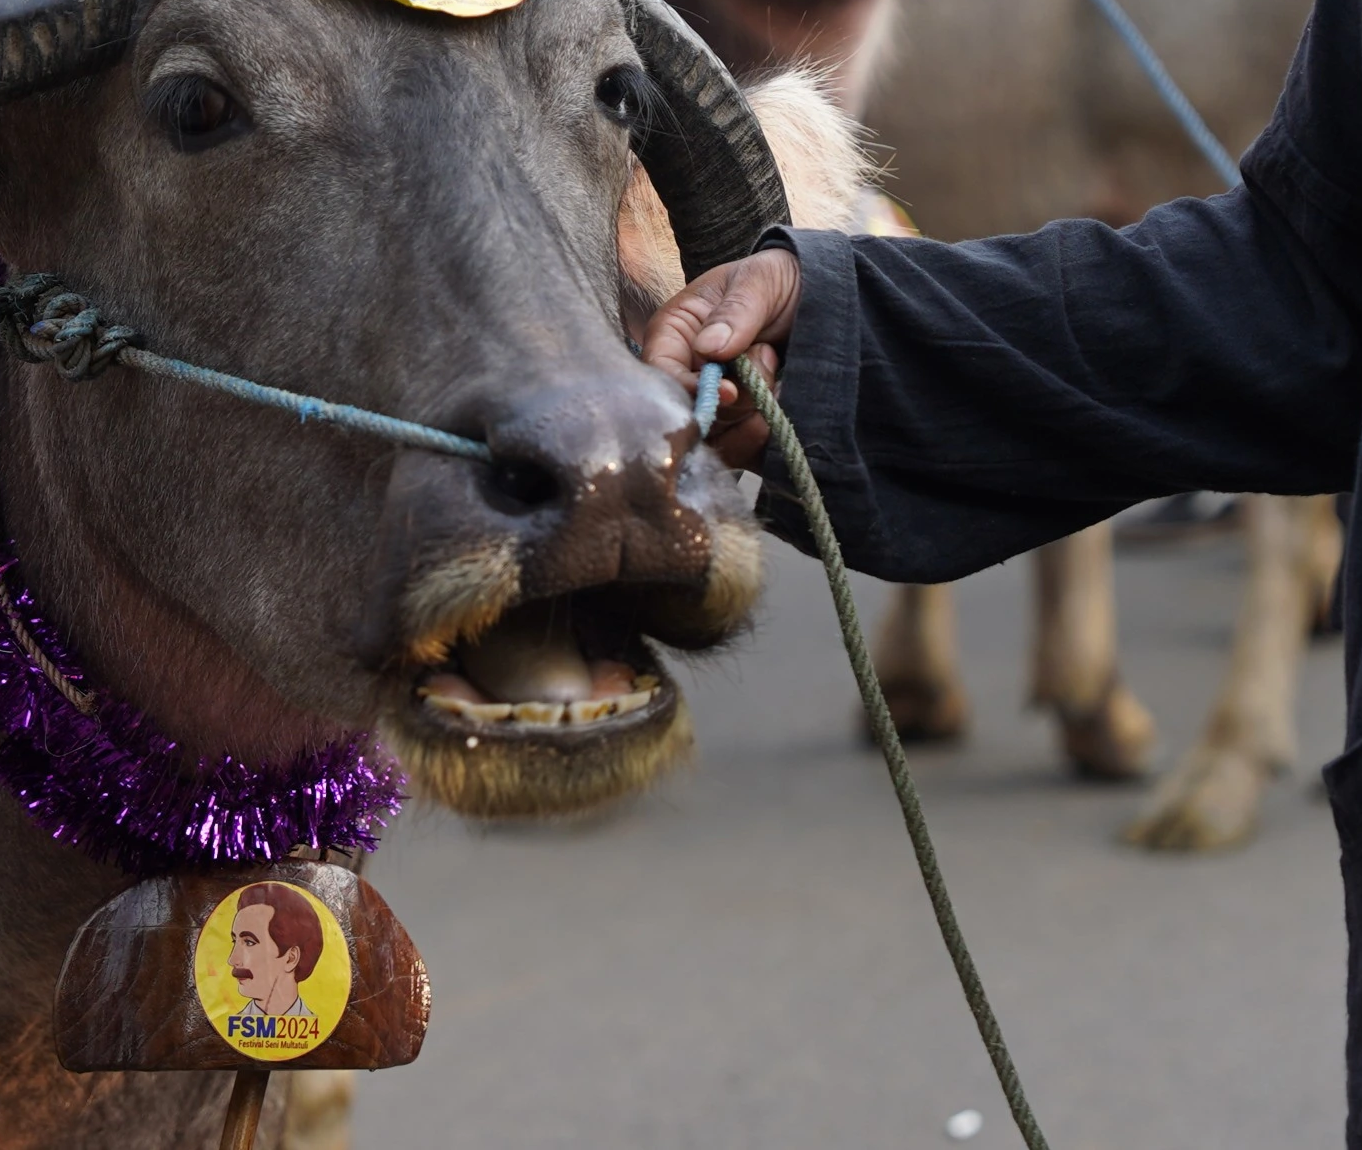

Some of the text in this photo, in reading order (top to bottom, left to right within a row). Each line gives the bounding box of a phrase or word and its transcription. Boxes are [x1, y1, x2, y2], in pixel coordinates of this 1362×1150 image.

[238, 1040, 309, 1049] Festival Seni Multatuli
